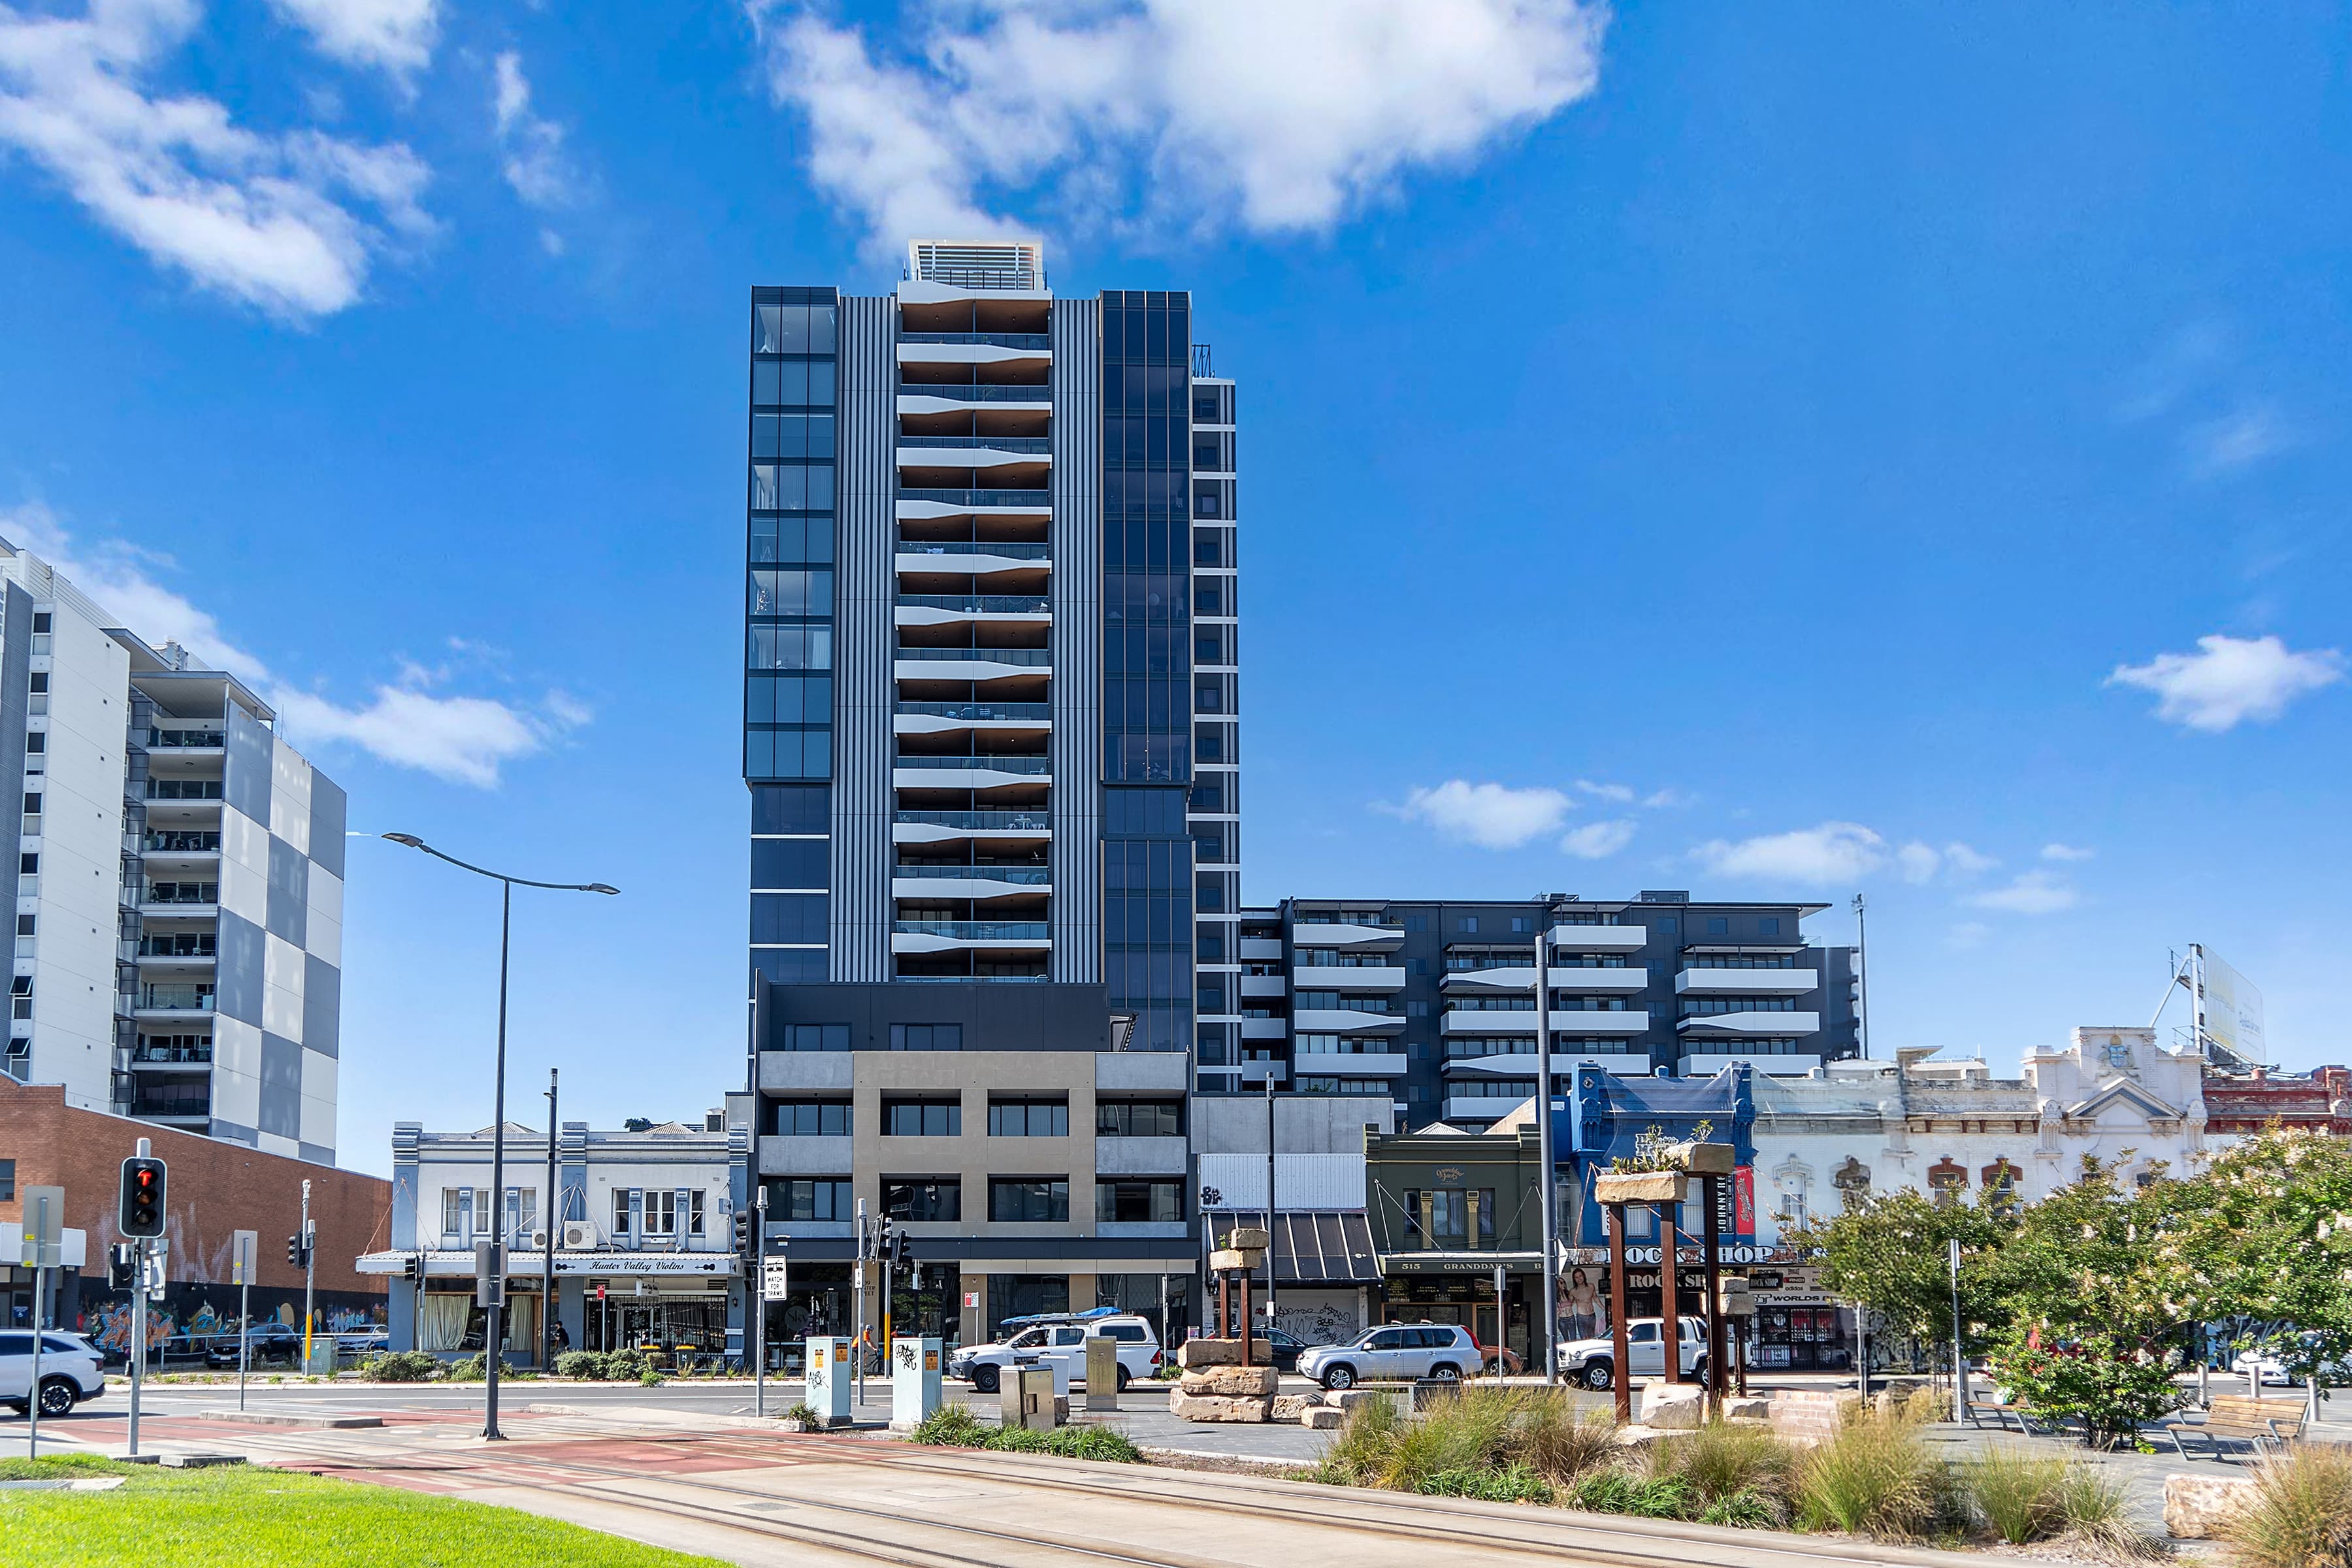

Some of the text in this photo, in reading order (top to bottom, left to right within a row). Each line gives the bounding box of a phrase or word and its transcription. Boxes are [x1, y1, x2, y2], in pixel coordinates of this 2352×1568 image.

[1717, 1192, 1727, 1232] JOHNNY
[1605, 1247, 1687, 1264] OCK
[589, 1261, 685, 1273] Hunter Valley Violins
[1765, 1277, 1778, 1286] SHOP
